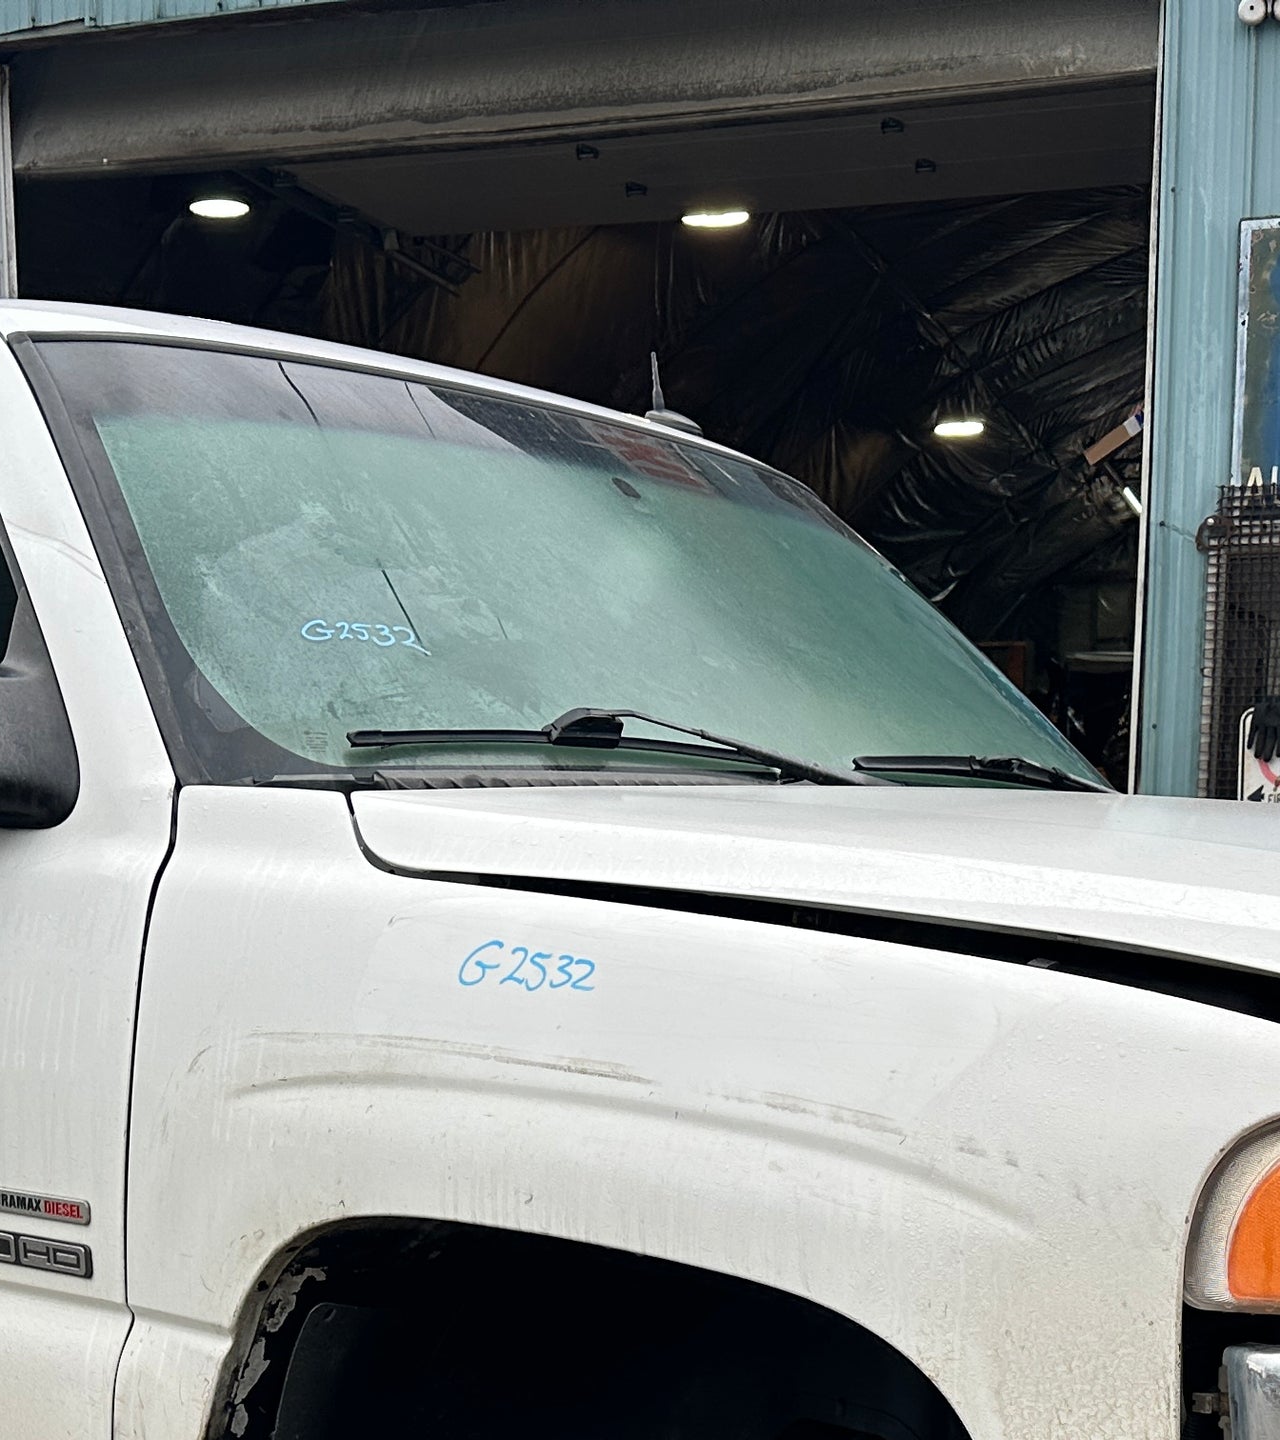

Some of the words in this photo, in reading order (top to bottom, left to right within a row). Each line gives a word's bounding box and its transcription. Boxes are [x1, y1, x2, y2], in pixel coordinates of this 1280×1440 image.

[301, 619, 431, 656] G2532
[458, 939, 596, 992] G2532
[43, 1200, 84, 1219] DIESEL
